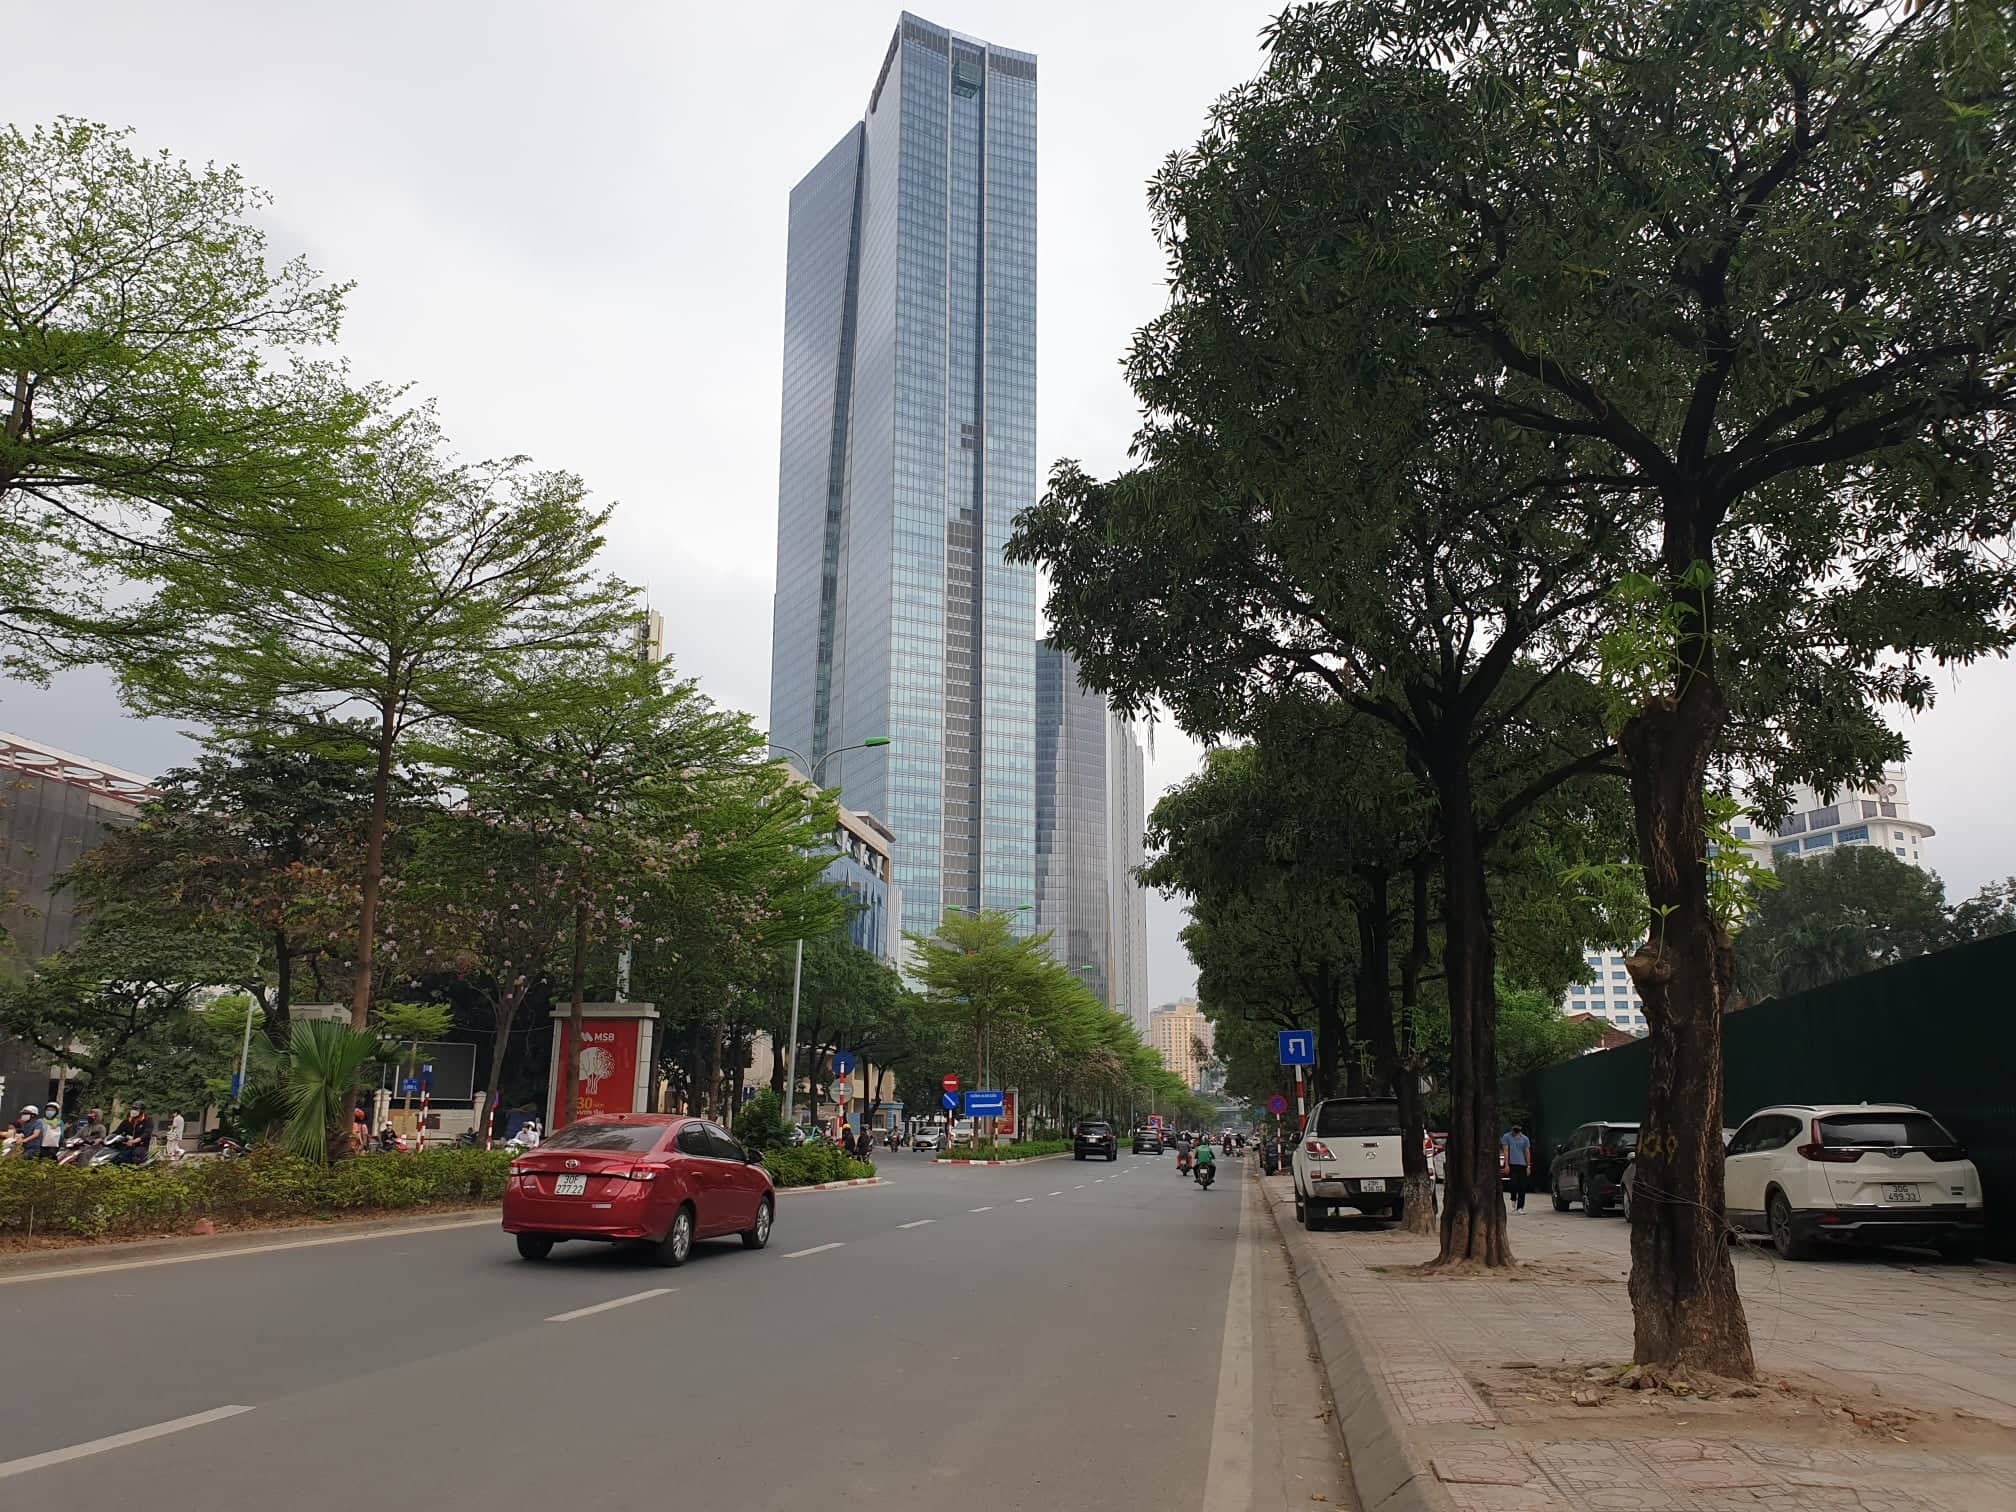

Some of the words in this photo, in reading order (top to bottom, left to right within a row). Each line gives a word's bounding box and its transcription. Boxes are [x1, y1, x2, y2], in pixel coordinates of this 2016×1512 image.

[594, 1032, 615, 1041] MSB
[575, 1096, 593, 1110] 30
[563, 1175, 579, 1184] 30F
